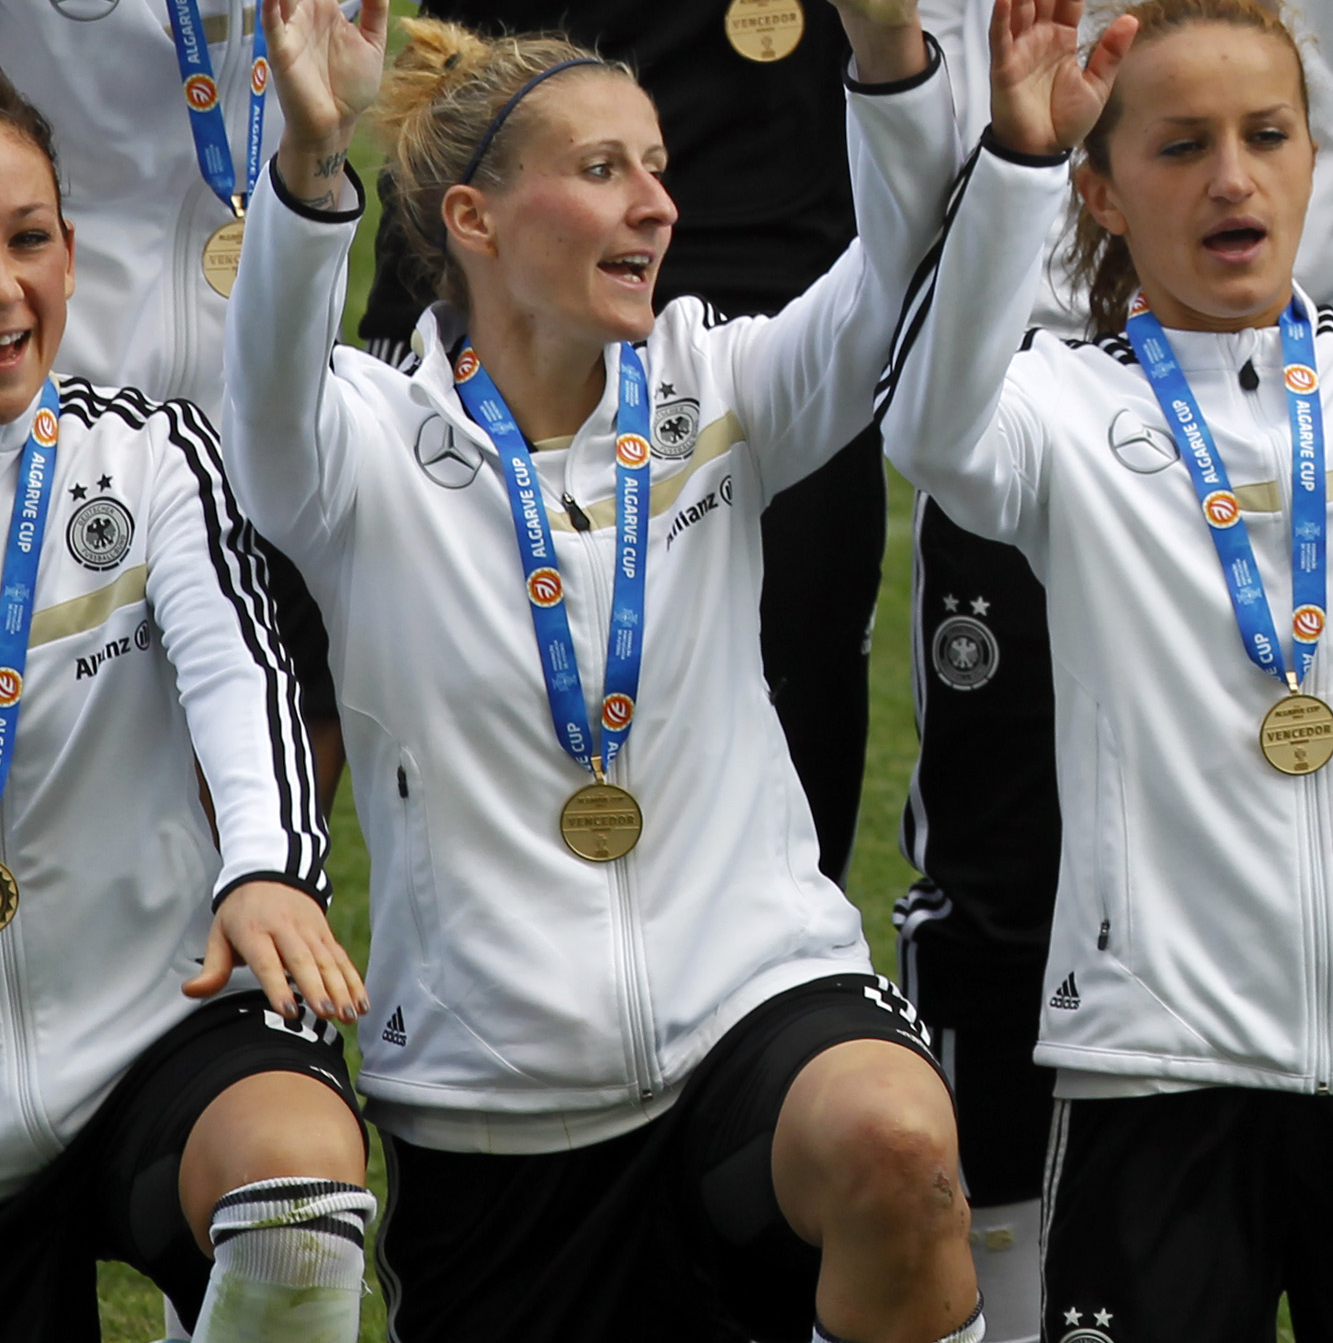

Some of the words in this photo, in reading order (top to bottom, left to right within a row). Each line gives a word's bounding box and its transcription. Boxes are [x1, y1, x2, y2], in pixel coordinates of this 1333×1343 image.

[1171, 400, 1195, 422] CUP
[1296, 400, 1314, 458] ALGARVE
[1183, 423, 1219, 484] ALGARVE
[22, 450, 46, 519] ALGARVE
[512, 457, 528, 487] CUP
[1301, 461, 1315, 491] CUP
[521, 489, 548, 558] ALGARVE
[623, 476, 639, 544] ALGARVE
[17, 521, 35, 553] CUP
[622, 547, 636, 579] CUP
[1254, 633, 1273, 663] CUP
[566, 722, 585, 753] CUP
[1267, 724, 1332, 743] VENCEDOR
[569, 814, 635, 827] VENCEDOR
